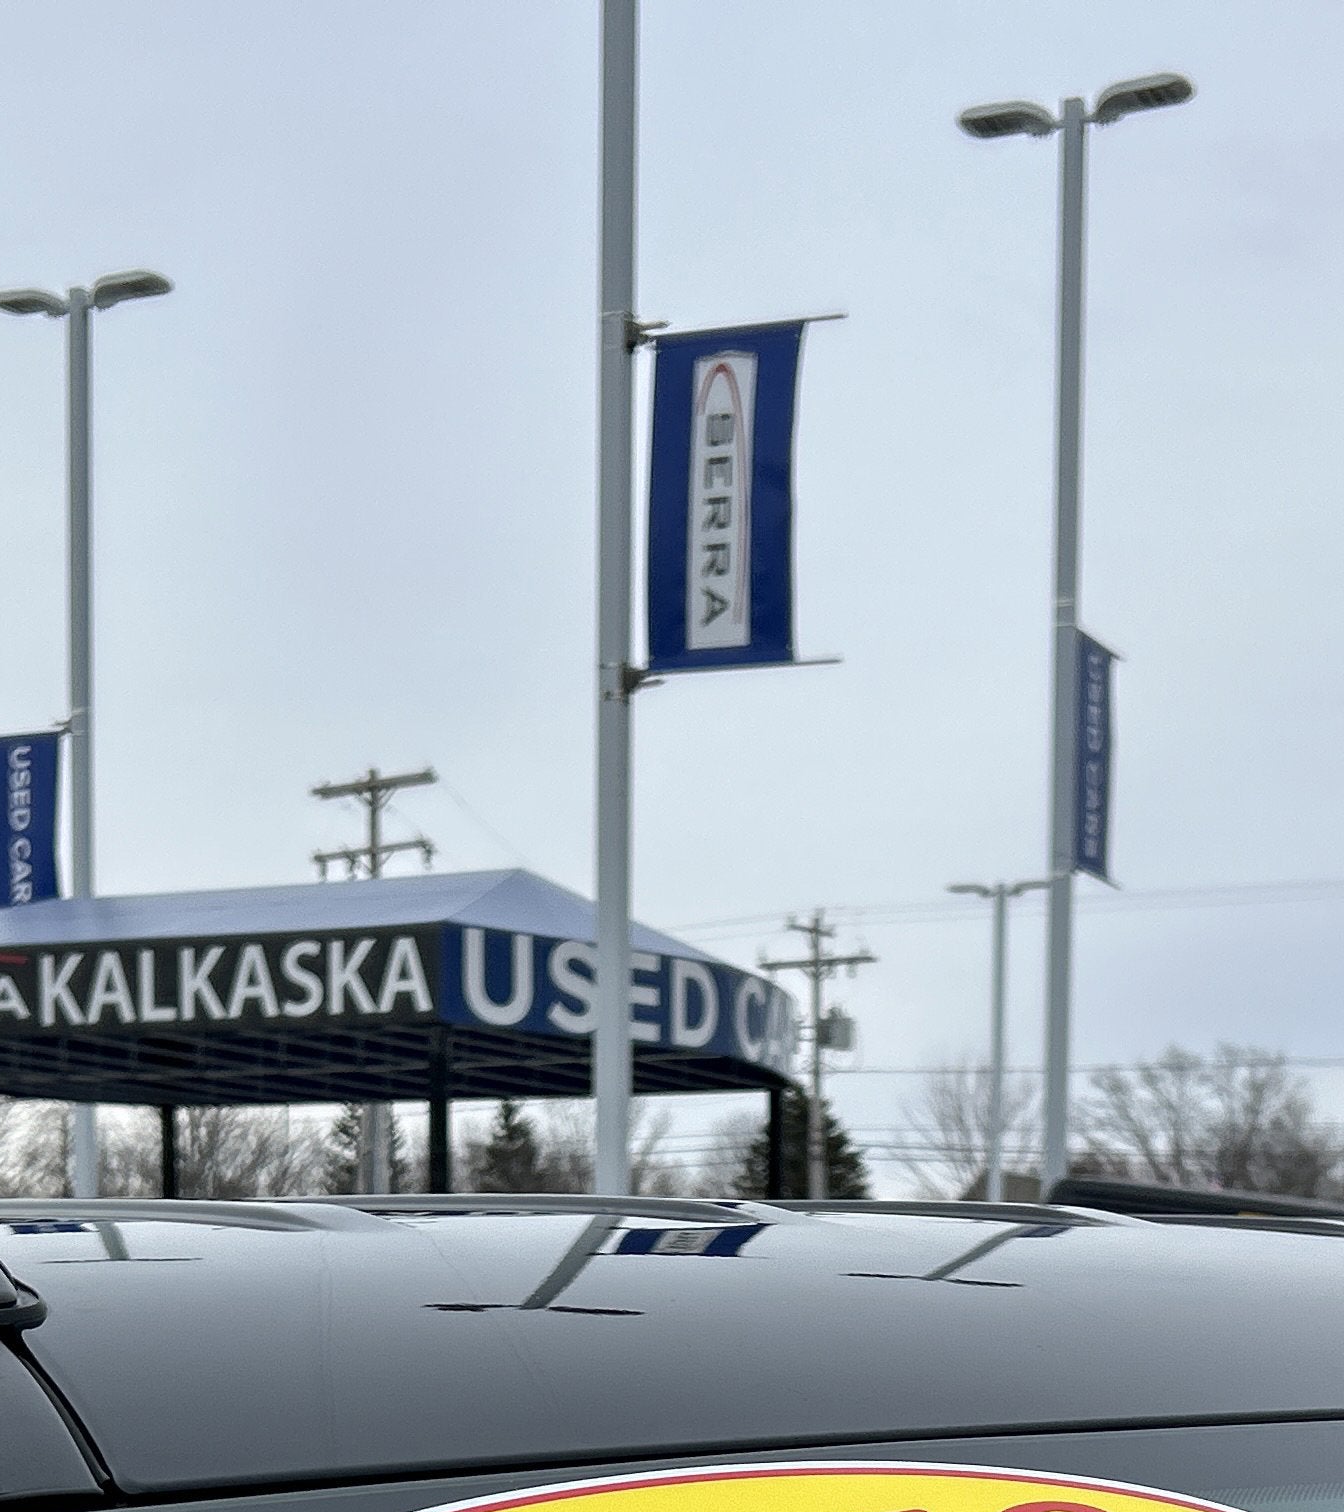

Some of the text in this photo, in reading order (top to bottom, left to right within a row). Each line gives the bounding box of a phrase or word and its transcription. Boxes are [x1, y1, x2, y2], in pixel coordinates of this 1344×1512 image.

[9, 745, 32, 832] USED
[37, 936, 434, 1028] KALKASKA
[461, 927, 719, 1048] USED
